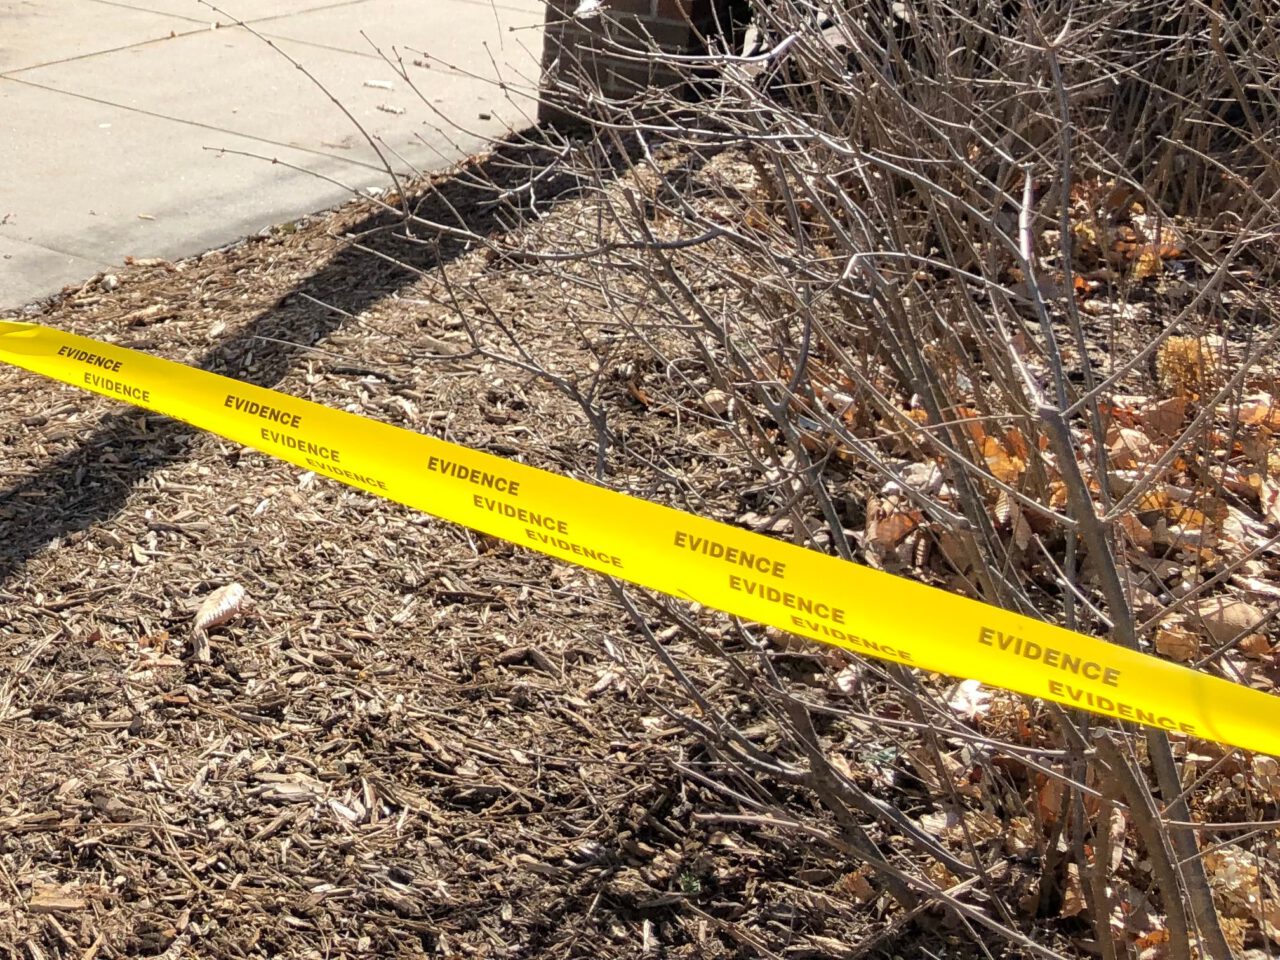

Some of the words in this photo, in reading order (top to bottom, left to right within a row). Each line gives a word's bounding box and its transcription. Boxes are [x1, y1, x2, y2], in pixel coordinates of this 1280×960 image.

[57, 346, 123, 373] EVIDENCE
[83, 372, 151, 403] EVIDENCE
[224, 395, 301, 429] EVIDENCE
[260, 428, 340, 463] EVIDENCE
[306, 458, 389, 491] EVIDENCE
[427, 456, 520, 496] EVIDENCE
[473, 494, 568, 535] EVIDENCE
[525, 528, 624, 569] EVIDENCE
[674, 531, 787, 579] EVIDENCE
[729, 574, 846, 624] EVIDENCE
[790, 614, 915, 662] EVIDENCE
[978, 626, 1122, 688] EVIDENCE
[1048, 679, 1197, 736] EVIDENCE
